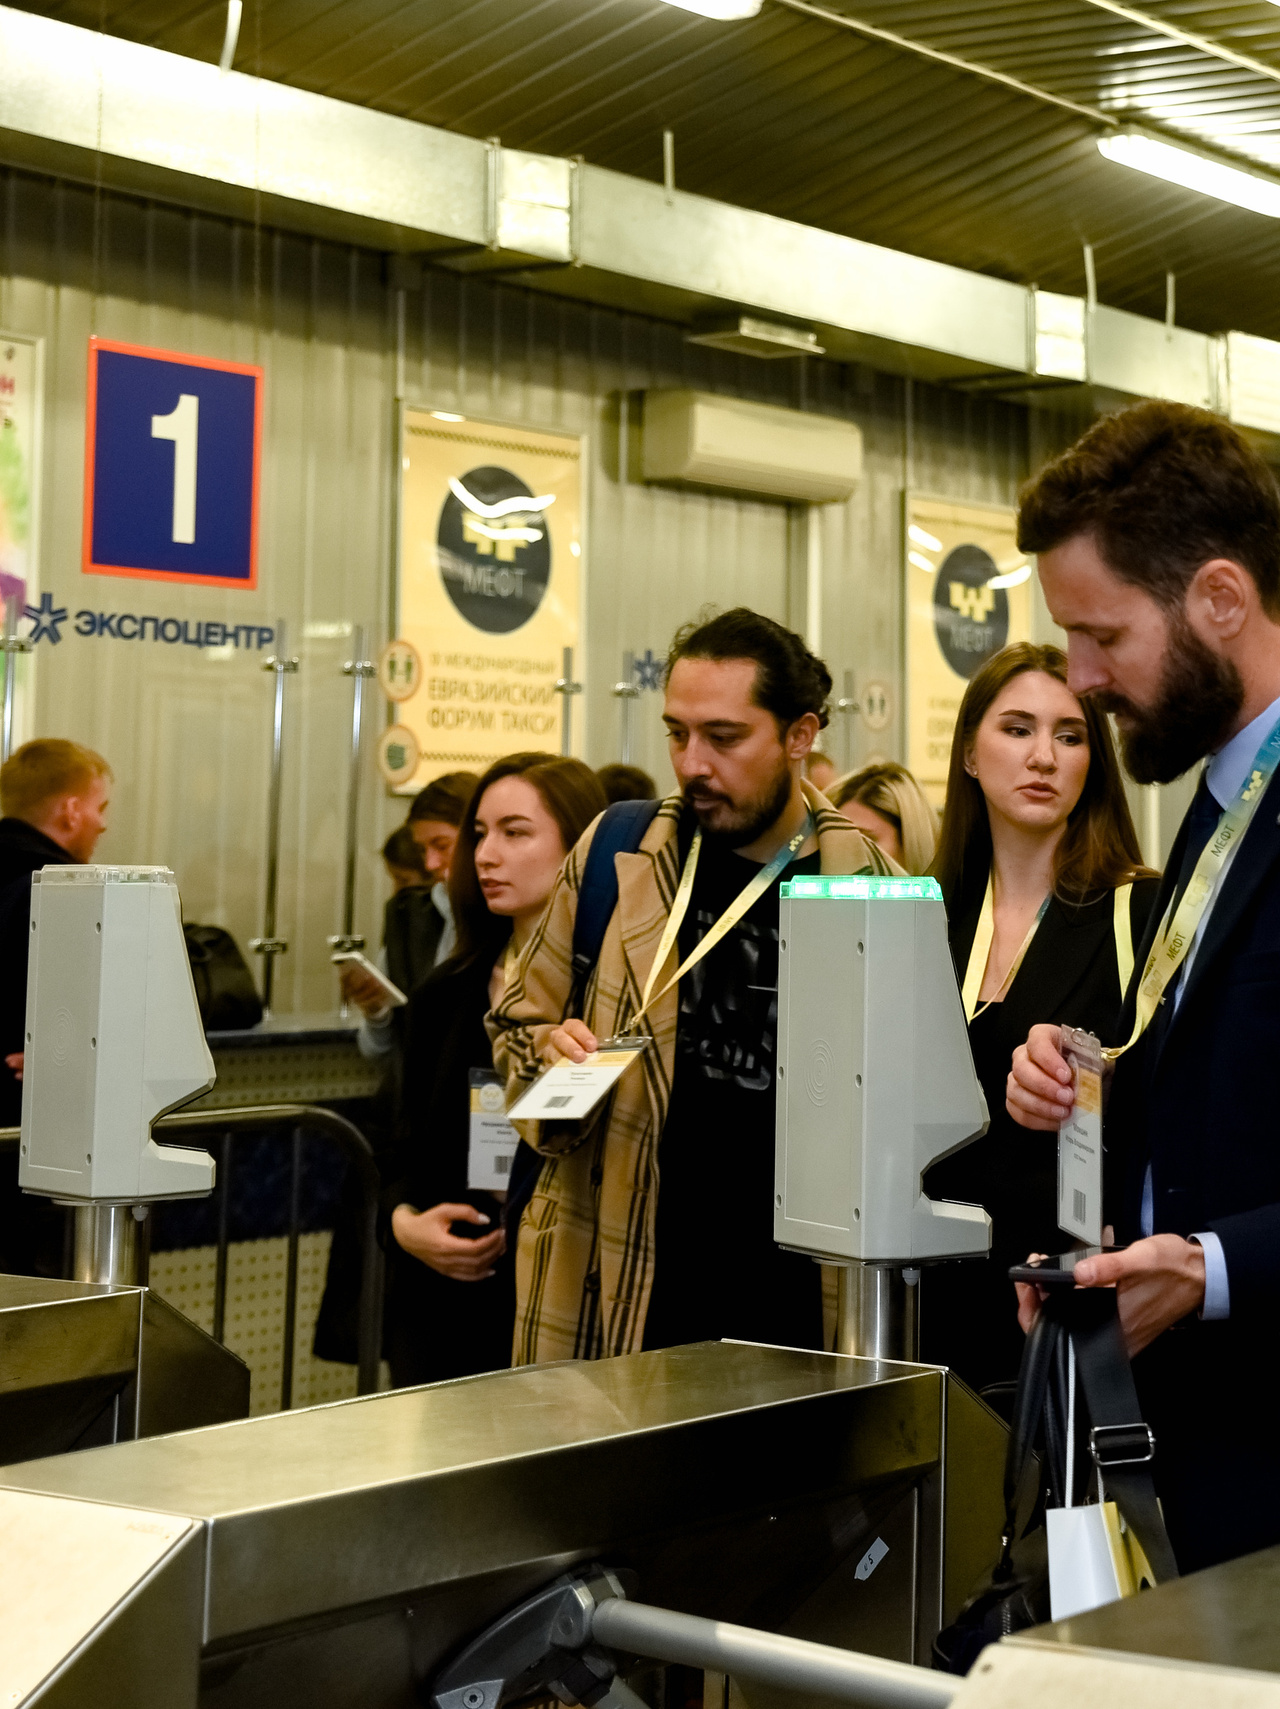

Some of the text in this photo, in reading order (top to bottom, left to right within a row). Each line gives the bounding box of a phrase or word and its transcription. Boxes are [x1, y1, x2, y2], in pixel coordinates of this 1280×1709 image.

[151, 393, 199, 544] 1
[74, 610, 275, 650] ЭКСПОЦЕНТР
[427, 706, 557, 735] ФОРУМ ТАКСИ
[1211, 824, 1235, 857] МЕФТ
[1166, 931, 1187, 961] МЕФТ
